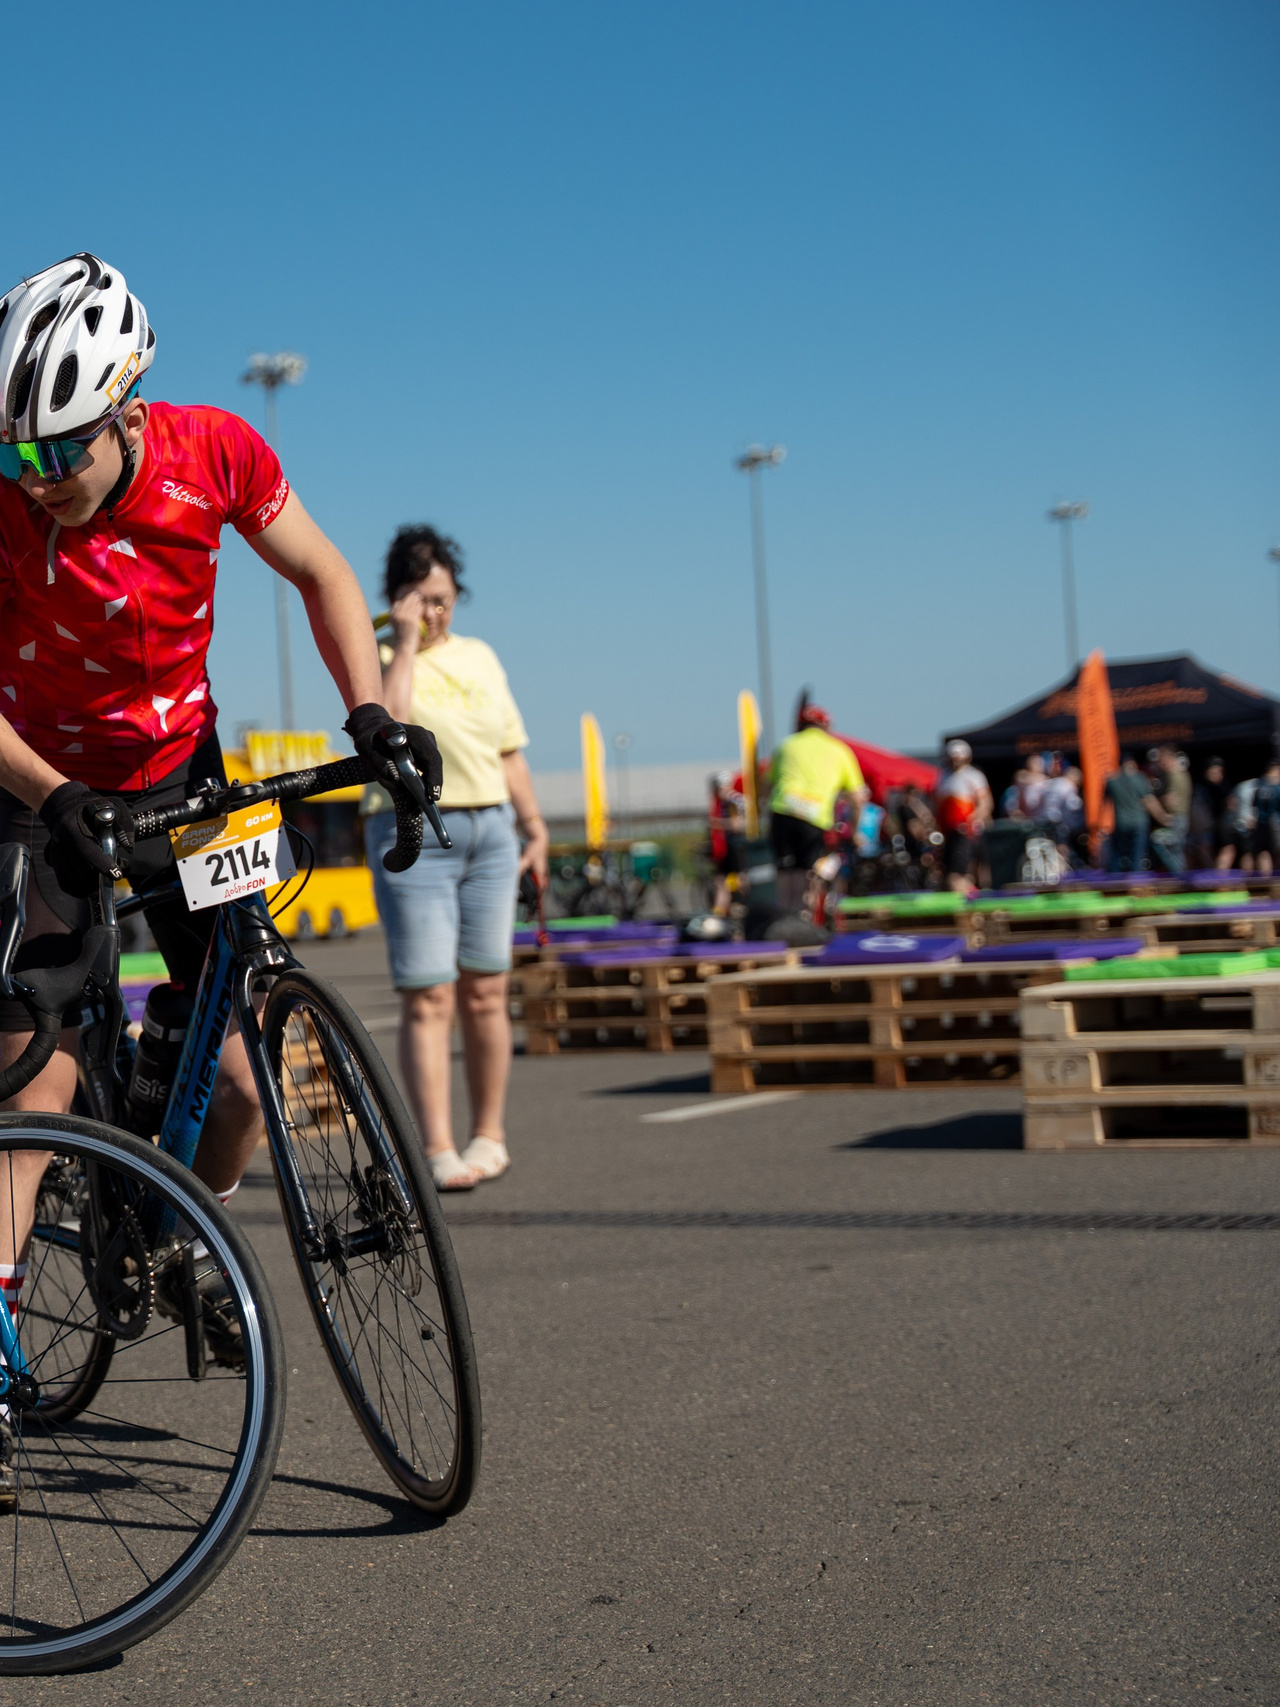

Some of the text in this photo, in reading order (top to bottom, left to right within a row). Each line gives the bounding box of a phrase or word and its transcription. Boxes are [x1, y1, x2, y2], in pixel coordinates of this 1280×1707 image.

[117, 367, 133, 392] 2114
[245, 815, 260, 828] 60
[181, 825, 216, 841] GRAN
[181, 831, 225, 848] FONDO
[205, 839, 271, 887] 2114
